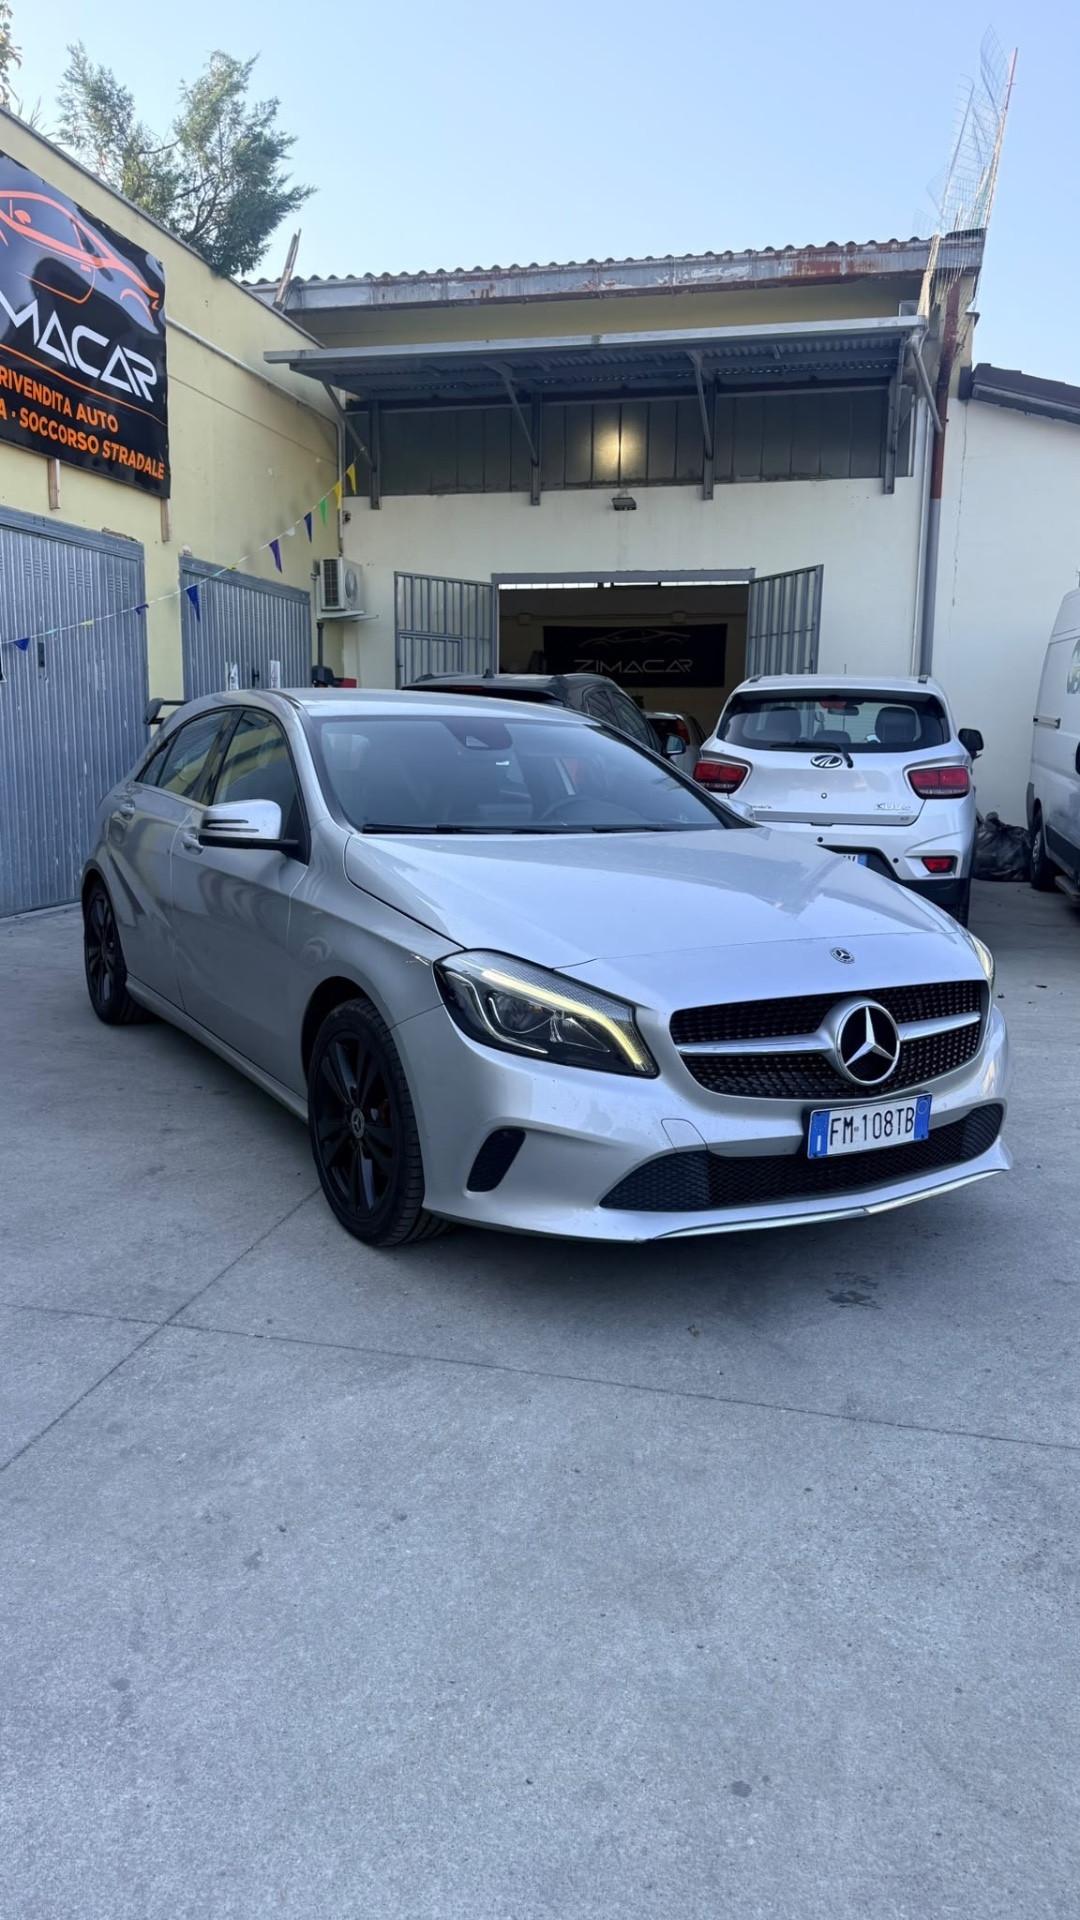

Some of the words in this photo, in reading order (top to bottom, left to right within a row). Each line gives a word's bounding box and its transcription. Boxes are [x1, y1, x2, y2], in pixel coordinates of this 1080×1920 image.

[0, 365, 73, 418] RIVENDITA
[76, 402, 119, 433] AUTO
[19, 407, 99, 455] SOCCORSO
[102, 441, 165, 480] STRADALE
[573, 659, 694, 674] ZIMACAR
